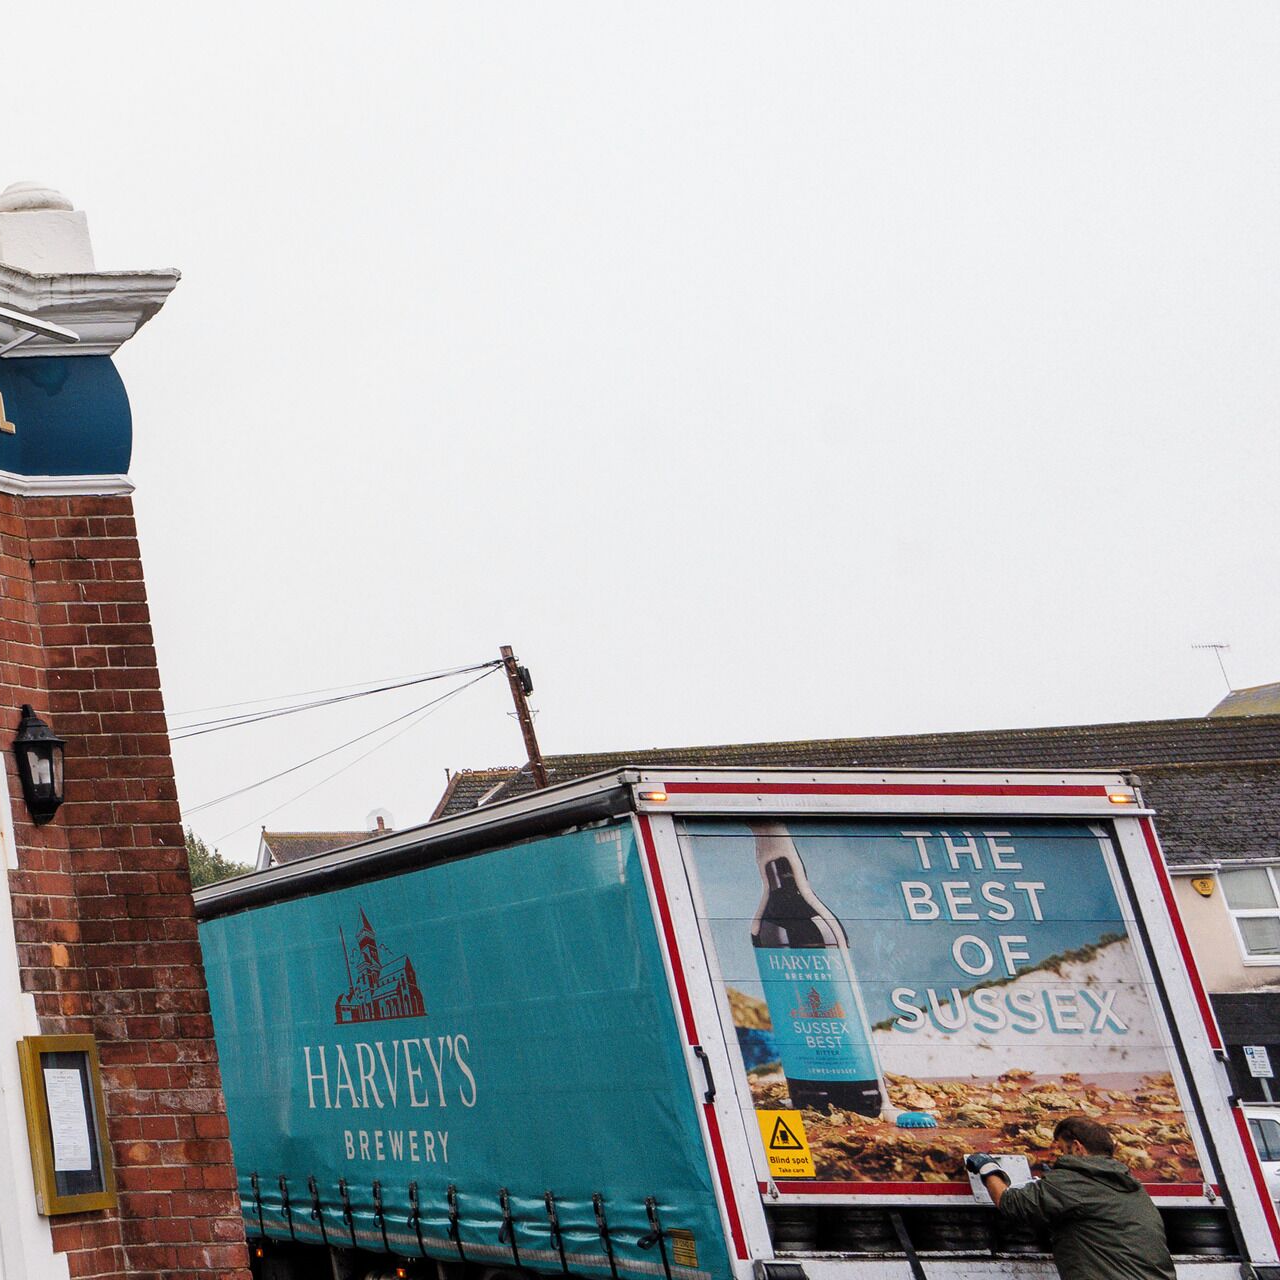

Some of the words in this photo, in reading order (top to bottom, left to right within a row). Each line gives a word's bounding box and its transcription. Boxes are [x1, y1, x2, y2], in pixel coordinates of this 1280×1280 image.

[900, 831, 1023, 871] THE
[899, 881, 1046, 923] BEST
[951, 935, 1031, 977] OF
[784, 972, 832, 981] BREWERY
[793, 1021, 850, 1034] SUSSEX
[891, 987, 1130, 1035] SUSSEX
[805, 1036, 843, 1048] BEST
[304, 1033, 477, 1109] HARVEY'S
[344, 1130, 449, 1163] BREWERY
[770, 1156, 791, 1164] Blind
